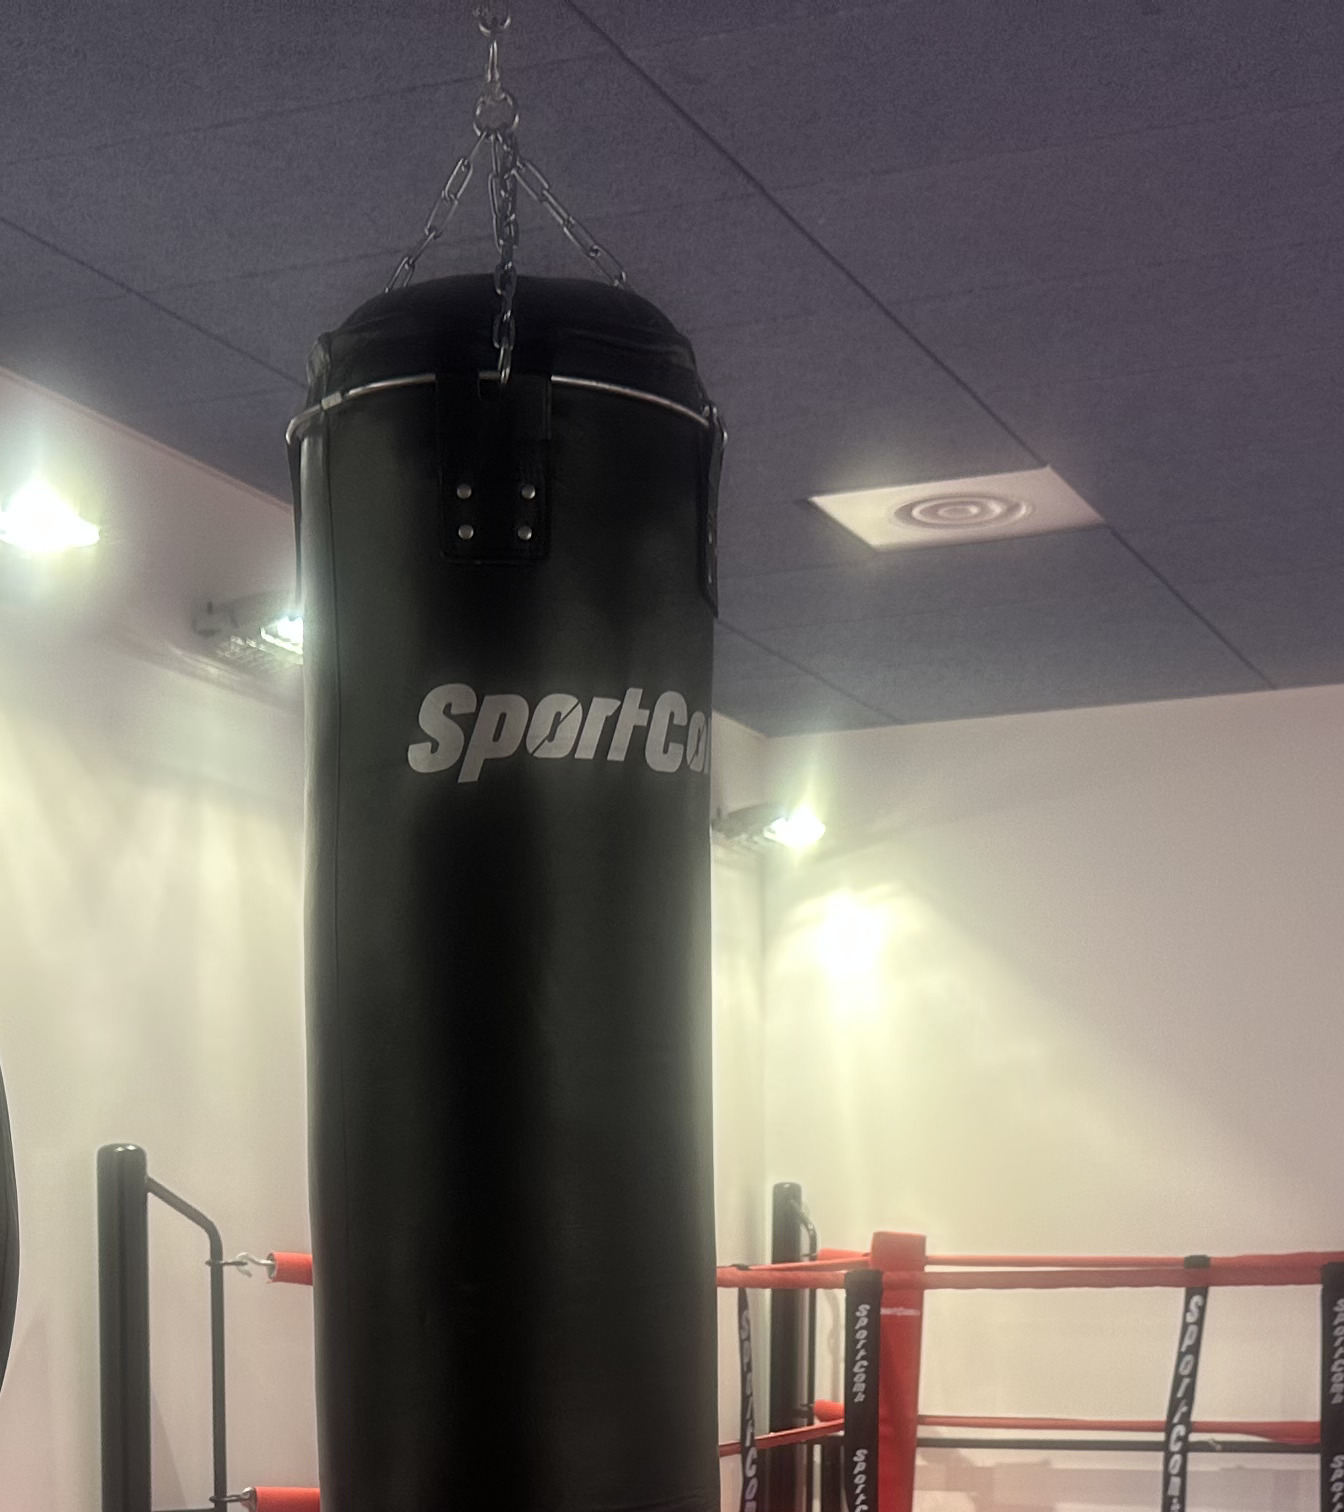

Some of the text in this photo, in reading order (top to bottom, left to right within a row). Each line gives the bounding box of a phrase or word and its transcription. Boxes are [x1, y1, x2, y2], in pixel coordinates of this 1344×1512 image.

[408, 683, 711, 783] SportCo
[852, 1304, 872, 1392] SportCom
[1167, 1295, 1203, 1496] SportCom
